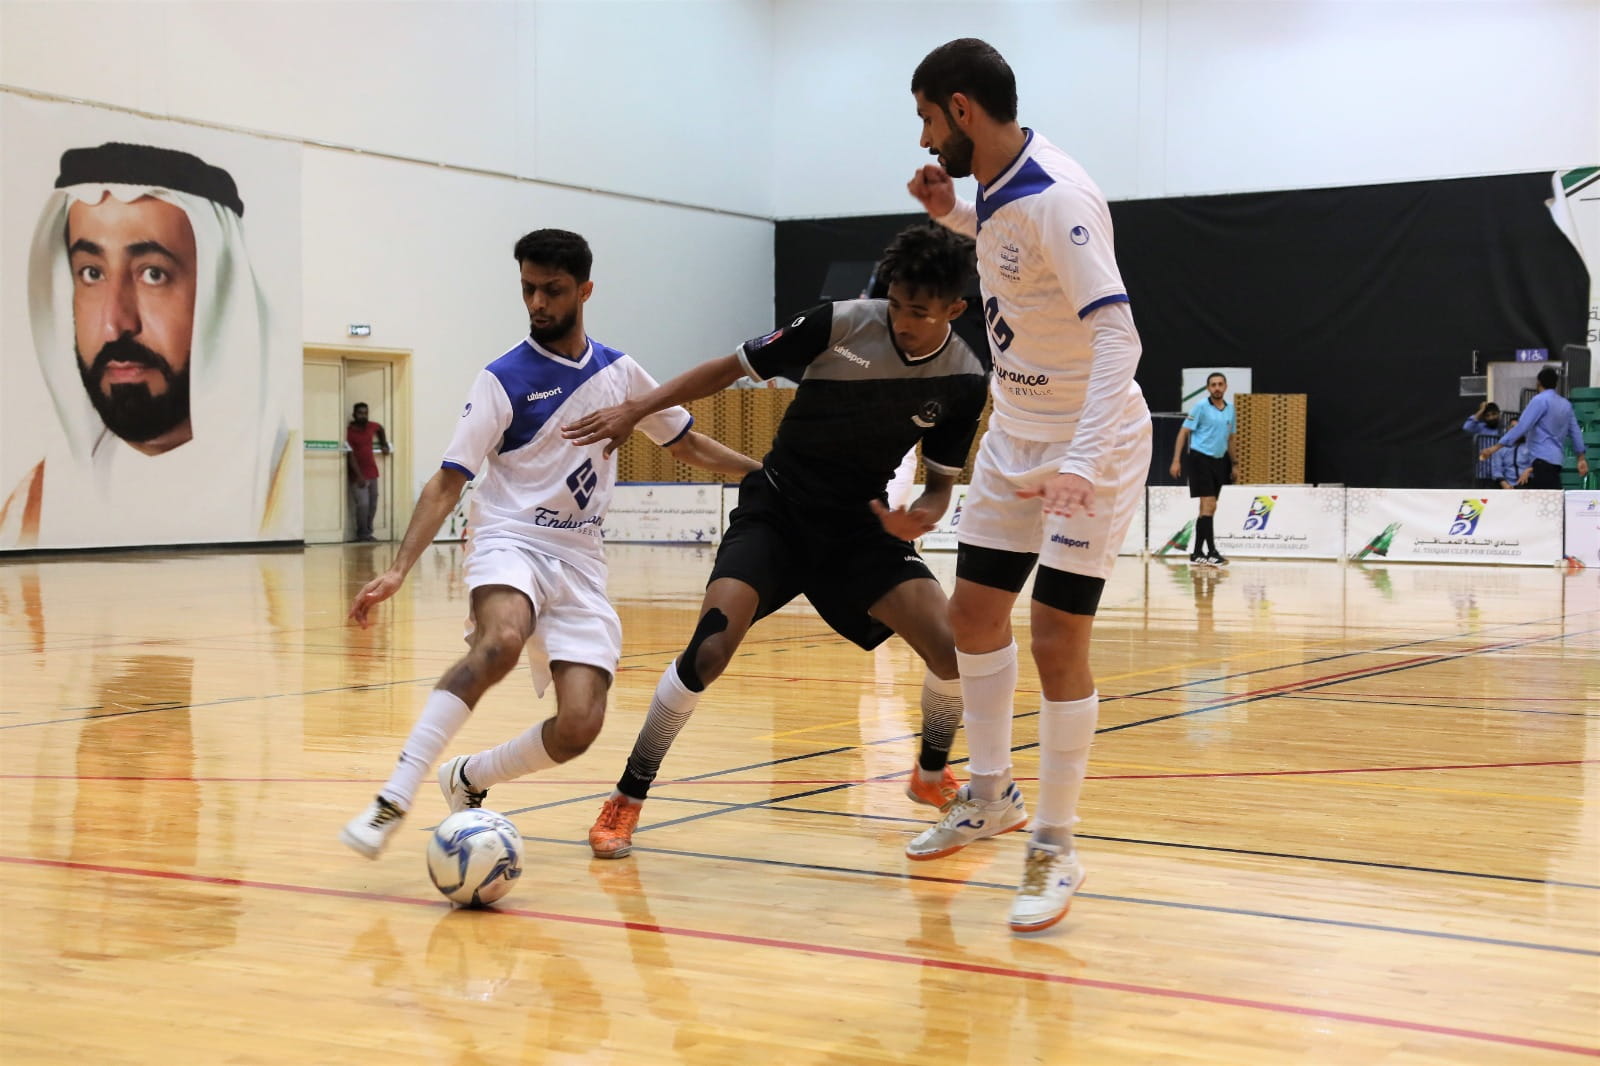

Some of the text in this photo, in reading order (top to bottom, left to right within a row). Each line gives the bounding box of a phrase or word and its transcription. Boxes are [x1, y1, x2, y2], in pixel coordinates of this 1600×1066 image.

[833, 345, 871, 369] uhlsport
[993, 365, 1049, 386] urance
[527, 386, 562, 401] uhlsport
[1051, 534, 1090, 549] uhlsport
